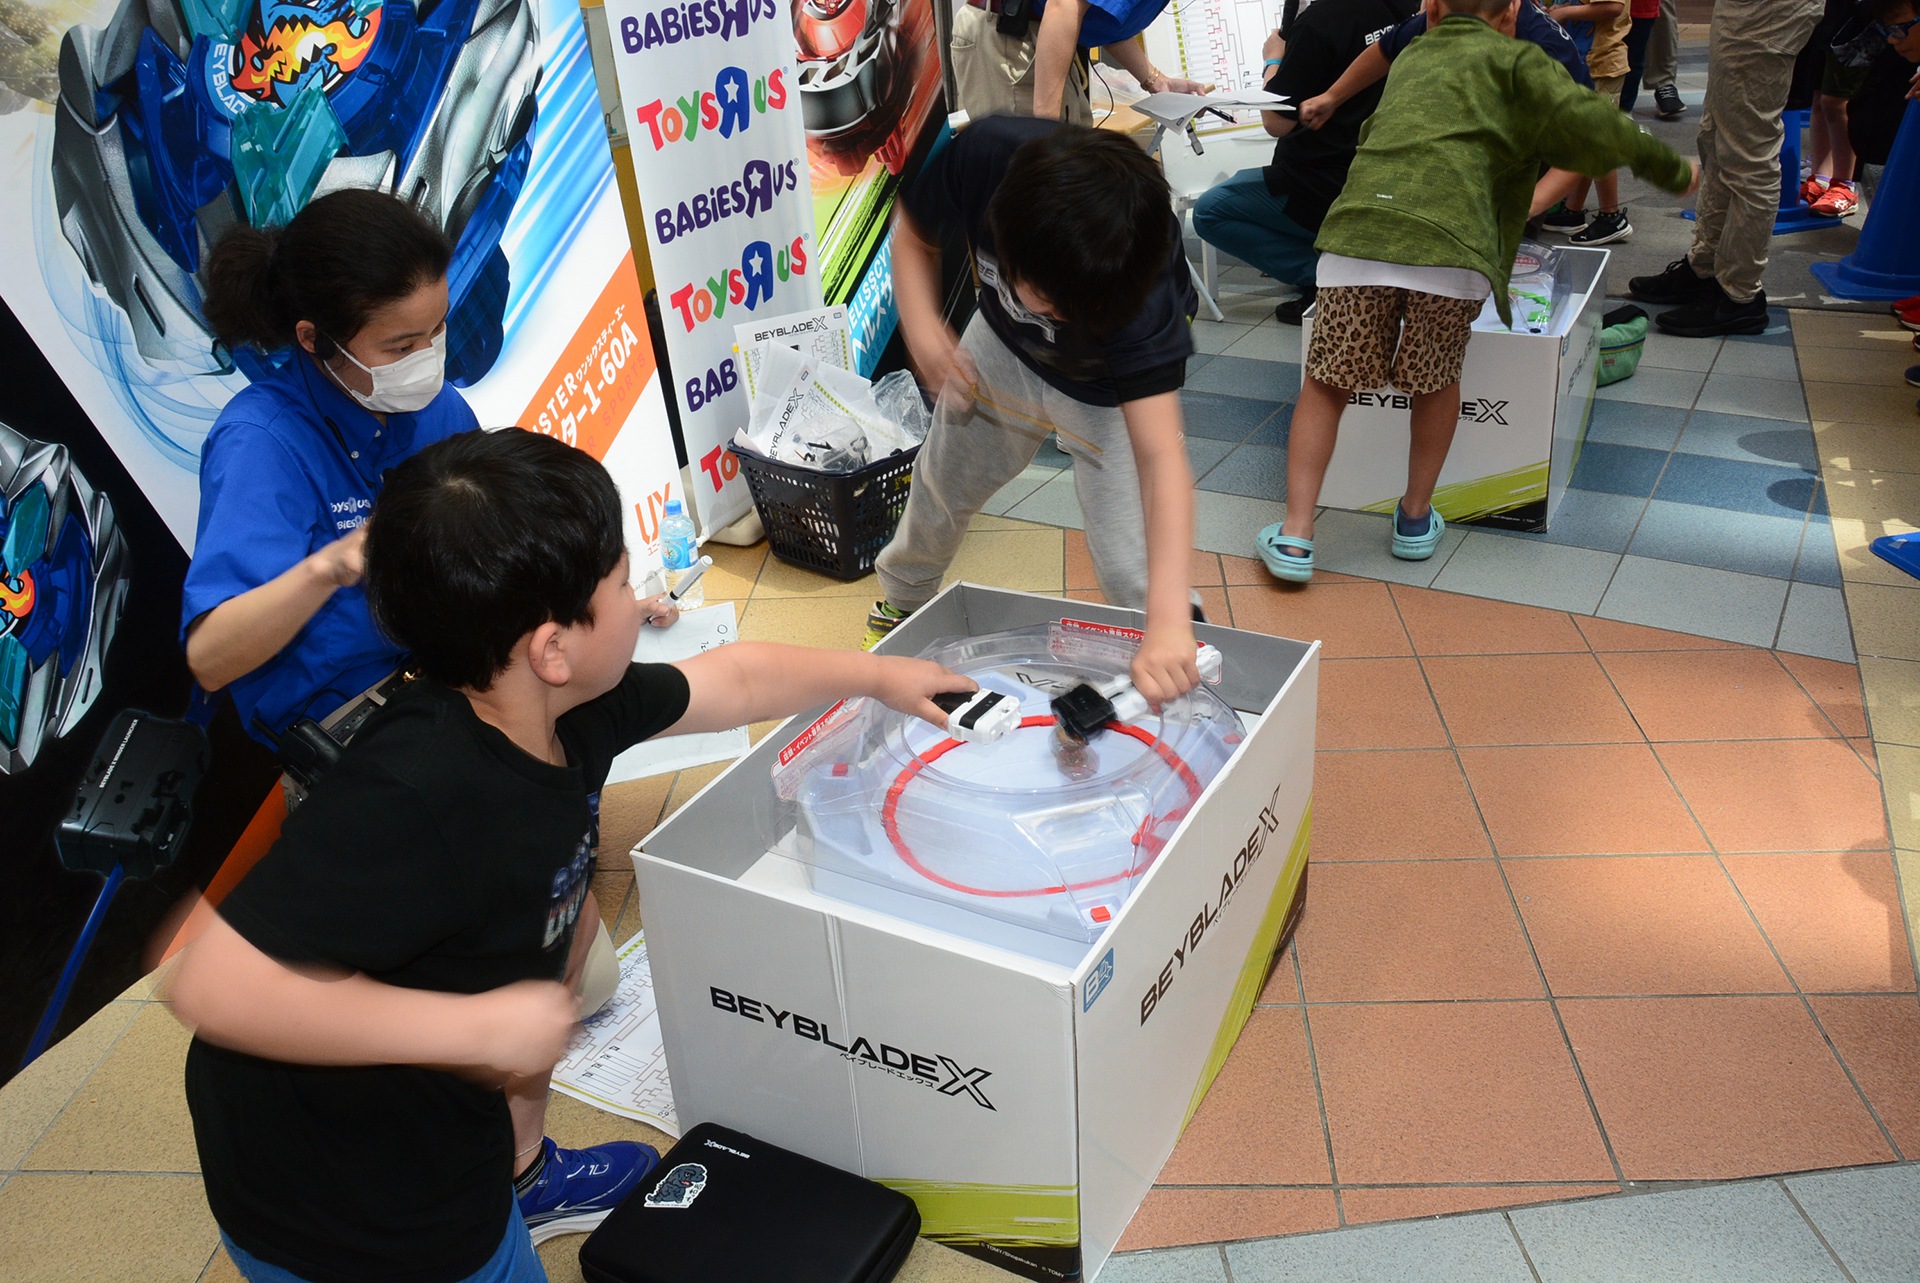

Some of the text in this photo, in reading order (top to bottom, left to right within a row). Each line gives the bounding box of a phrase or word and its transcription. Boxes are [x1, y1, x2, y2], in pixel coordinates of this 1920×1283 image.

[839, 1051, 934, 1089] ベイブレードエックス
